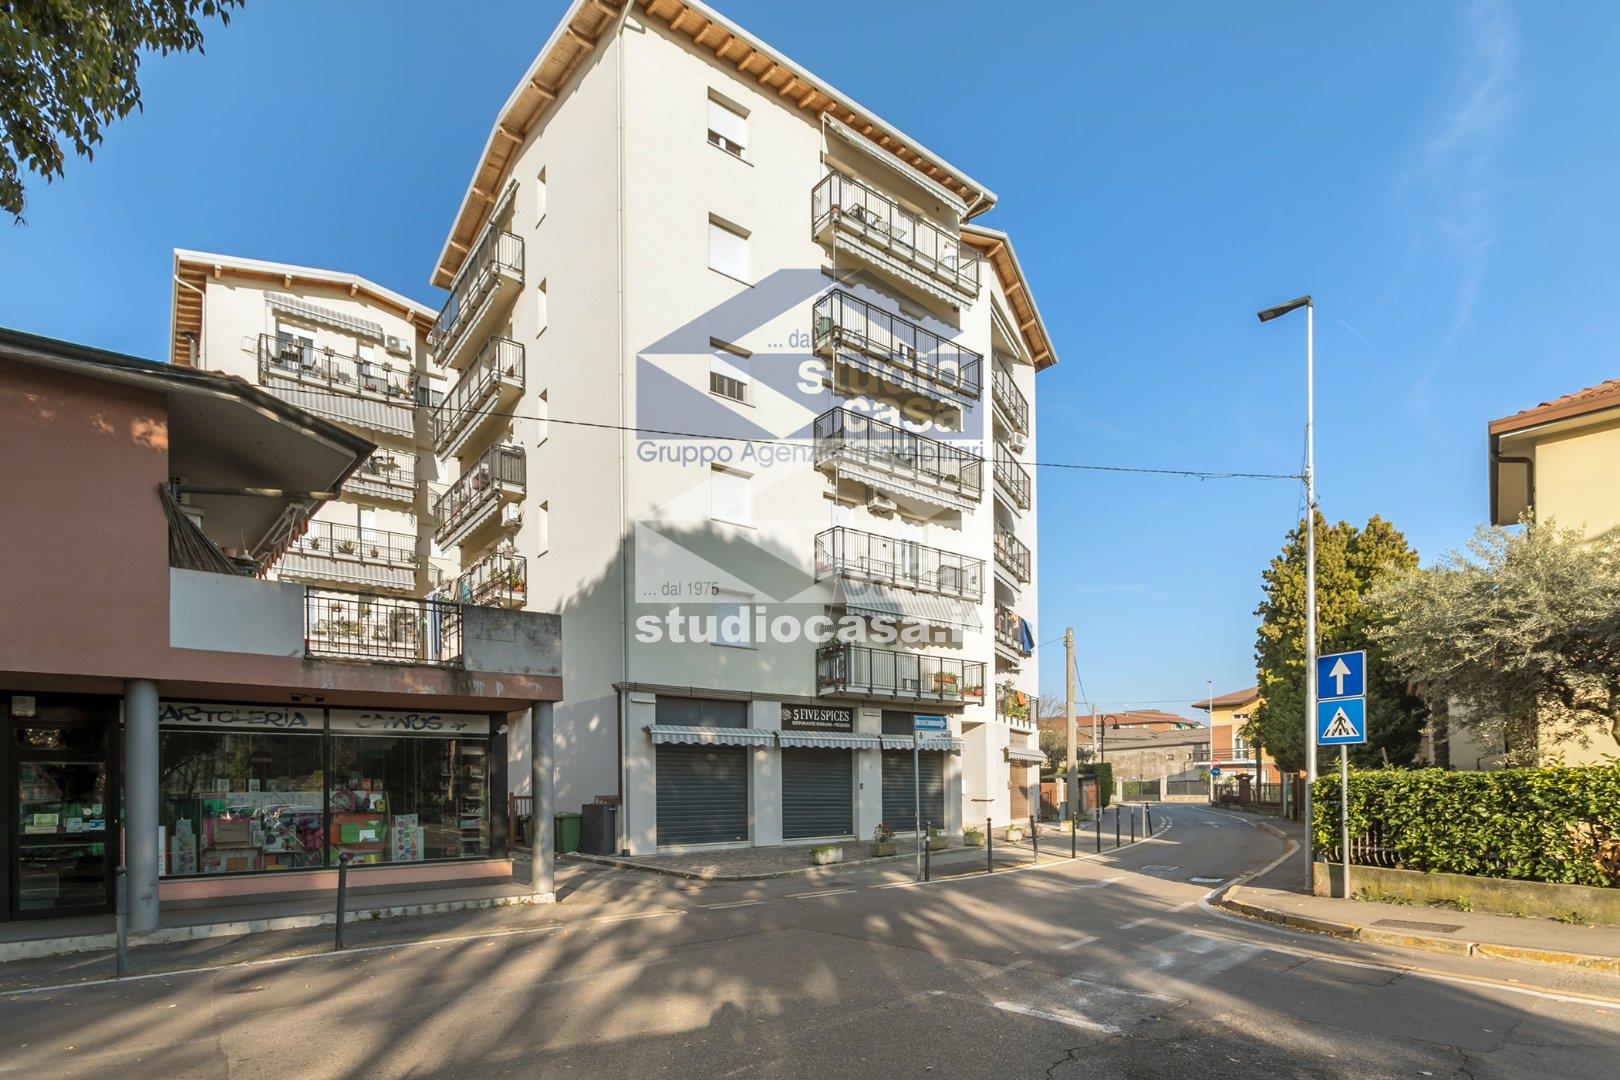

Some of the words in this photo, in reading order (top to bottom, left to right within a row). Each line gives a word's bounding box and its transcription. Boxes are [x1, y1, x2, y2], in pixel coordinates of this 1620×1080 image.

[159, 703, 309, 727] ARTOLERIA
[793, 709, 799, 721] 5
[800, 708, 820, 721] FIVE
[820, 709, 850, 722] SPICES
